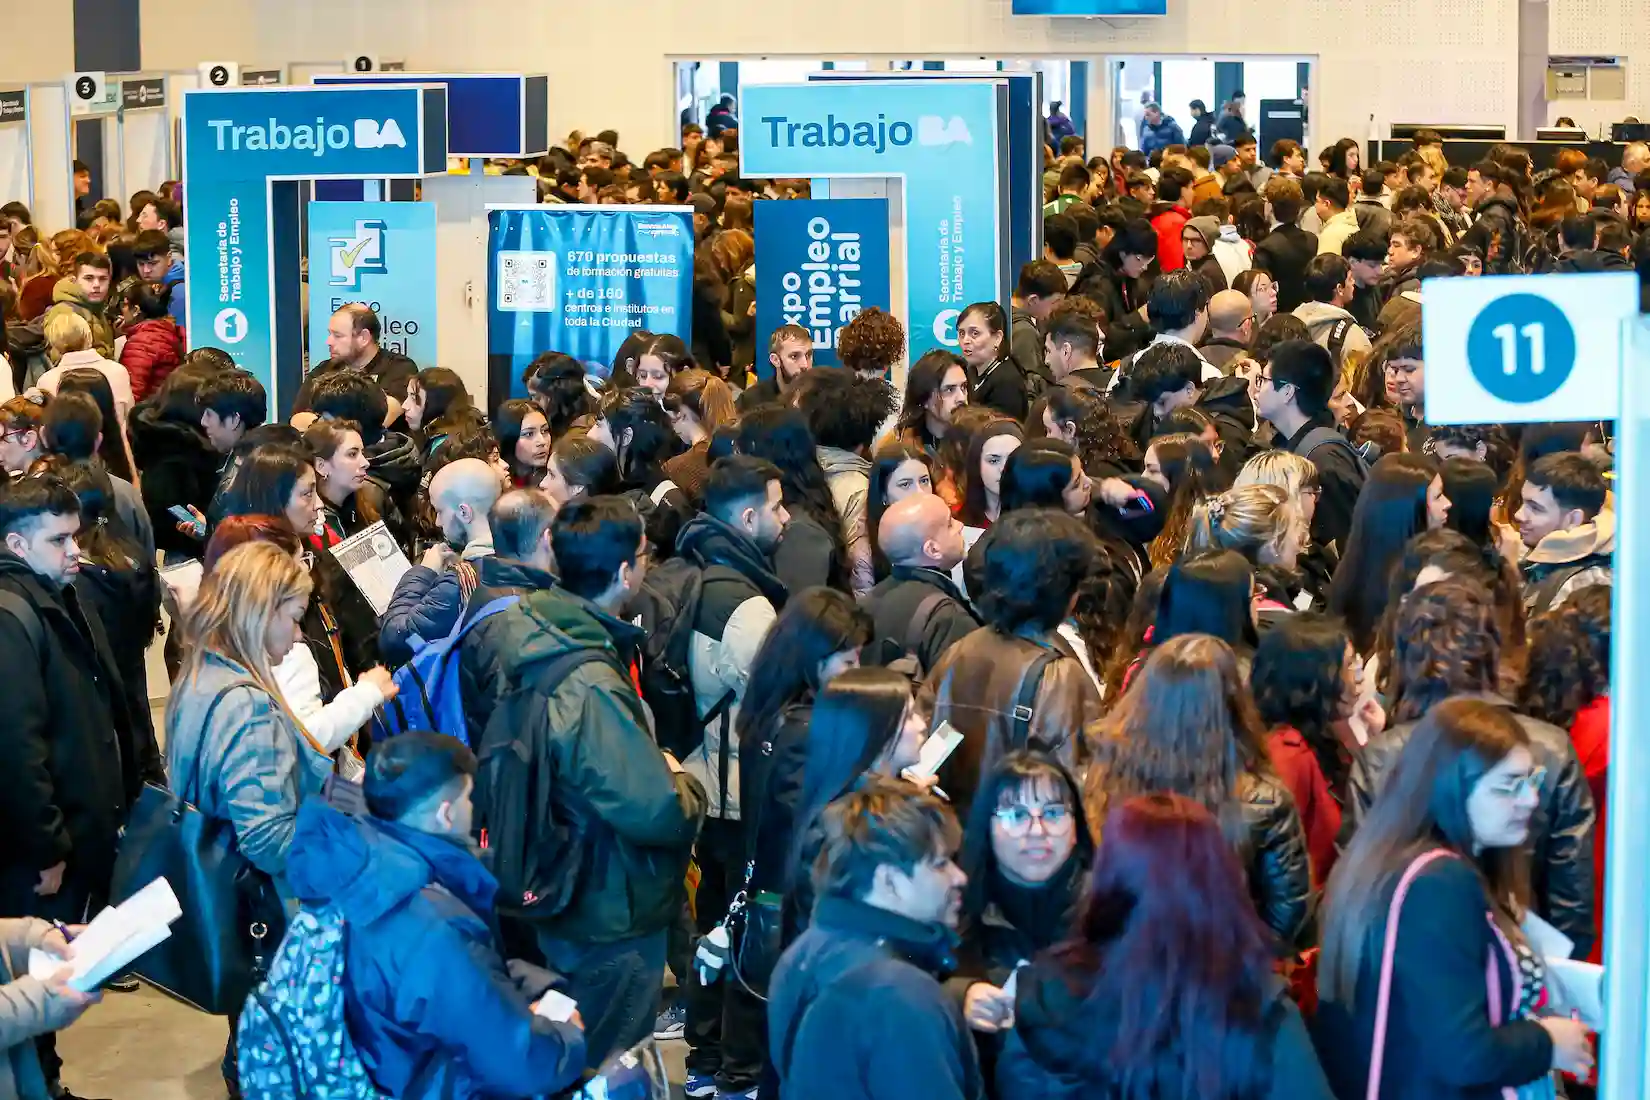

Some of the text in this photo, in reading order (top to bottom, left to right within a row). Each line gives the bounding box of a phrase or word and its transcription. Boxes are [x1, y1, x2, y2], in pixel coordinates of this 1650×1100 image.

[81, 82, 91, 94] 3
[213, 70, 225, 82] 2
[207, 116, 407, 157] Trabajo BA
[761, 113, 913, 154] Trabajo
[951, 195, 964, 243] Empleo
[216, 222, 229, 303] Secretaría de
[228, 198, 243, 303] Trabajo y Empleo
[596, 252, 677, 265] propuestas
[937, 219, 950, 303] Secretaría de
[566, 266, 579, 276] de
[634, 267, 679, 279] gratuitas
[801, 217, 836, 350] Empleo
[951, 255, 965, 303] Trabajo
[565, 303, 674, 315] centros e institutos en
[577, 288, 594, 299] de
[782, 272, 806, 326] xpo
[564, 316, 642, 328] toda la Ciudad
[1491, 321, 1546, 376] 11
